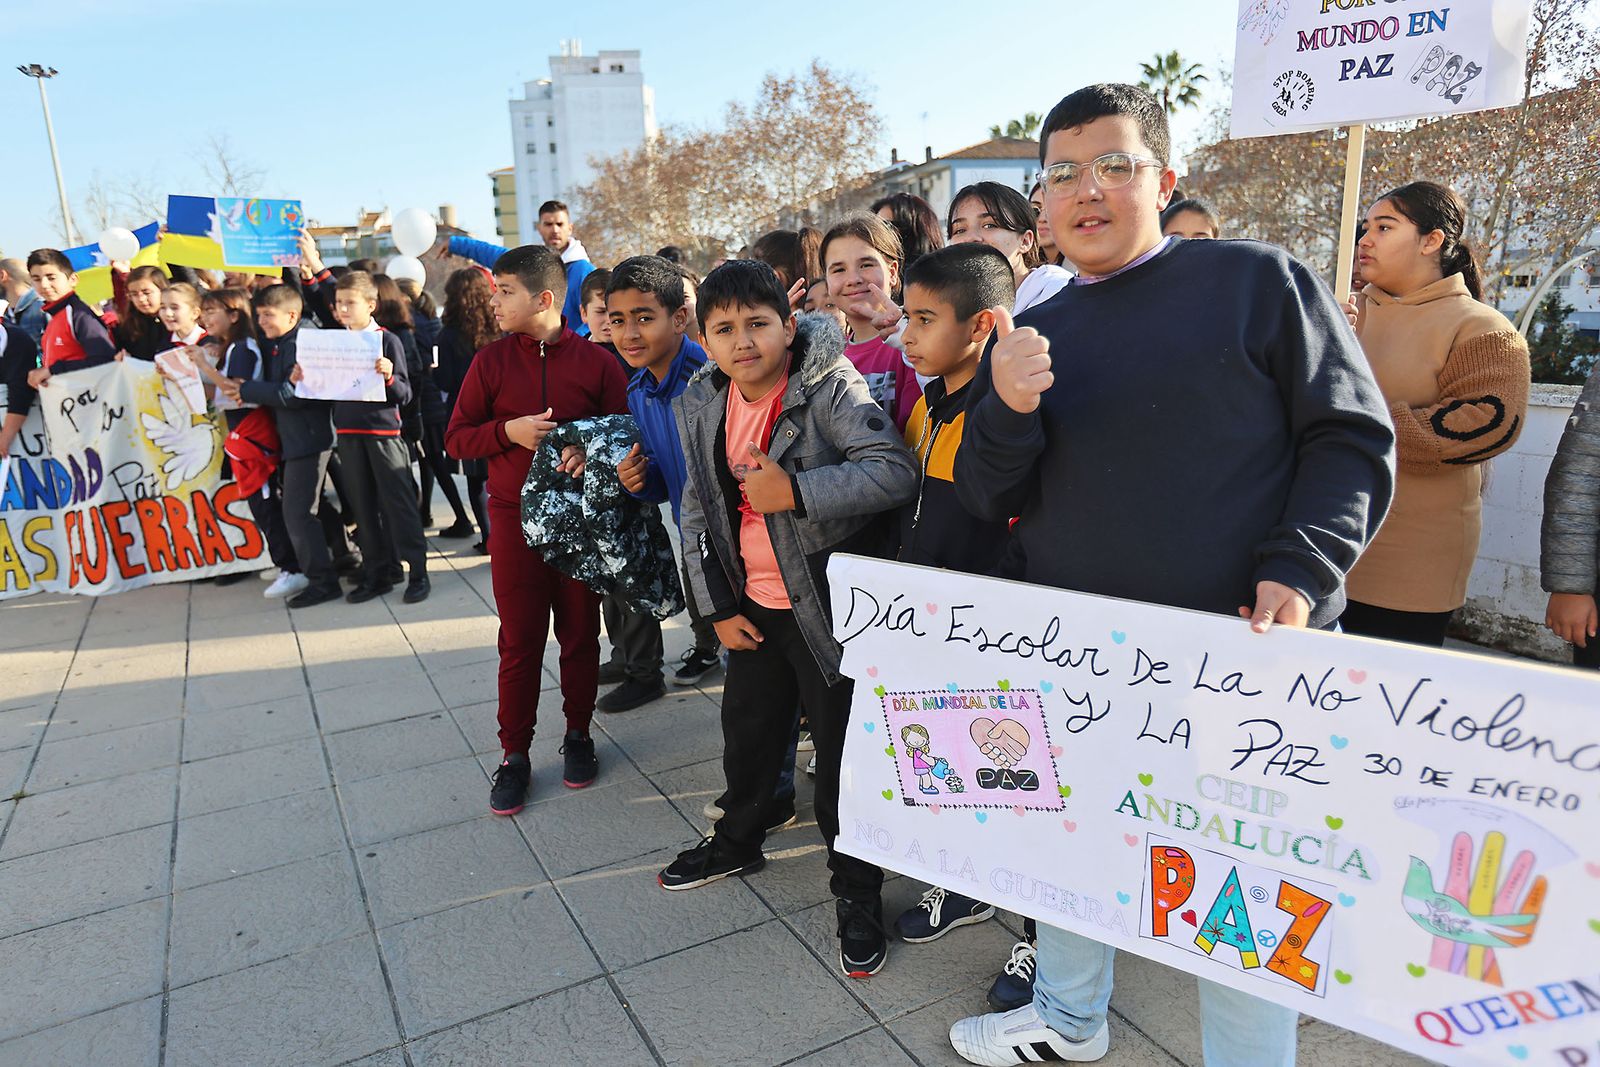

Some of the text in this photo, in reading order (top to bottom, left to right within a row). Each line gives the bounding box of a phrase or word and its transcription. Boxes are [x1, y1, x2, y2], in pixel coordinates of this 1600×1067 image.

[1296, 8, 1450, 52] MUNDO EN
[1338, 53, 1395, 82] PAZ
[1271, 101, 1287, 117] GAZA
[1272, 70, 1315, 111] STOP BOMBING
[839, 586, 927, 645] Día
[944, 604, 1110, 677] Escolar
[1192, 652, 1263, 697] La
[1287, 666, 1362, 712] No
[922, 696, 988, 711] MUNDIAL
[990, 695, 1008, 710] DE
[1009, 695, 1030, 710] LA
[1136, 701, 1193, 750] LA
[1229, 718, 1331, 785] PAZ
[1363, 753, 1402, 776] 30
[1419, 765, 1453, 788] DE
[1468, 777, 1581, 812] ENERO
[977, 769, 1038, 790] PAZ
[1196, 773, 1288, 818] CEIP
[1115, 790, 1373, 881] ANDALUCÍA
[853, 817, 1131, 937] NO A LA GUERRA
[1150, 845, 1333, 993] PAZ
